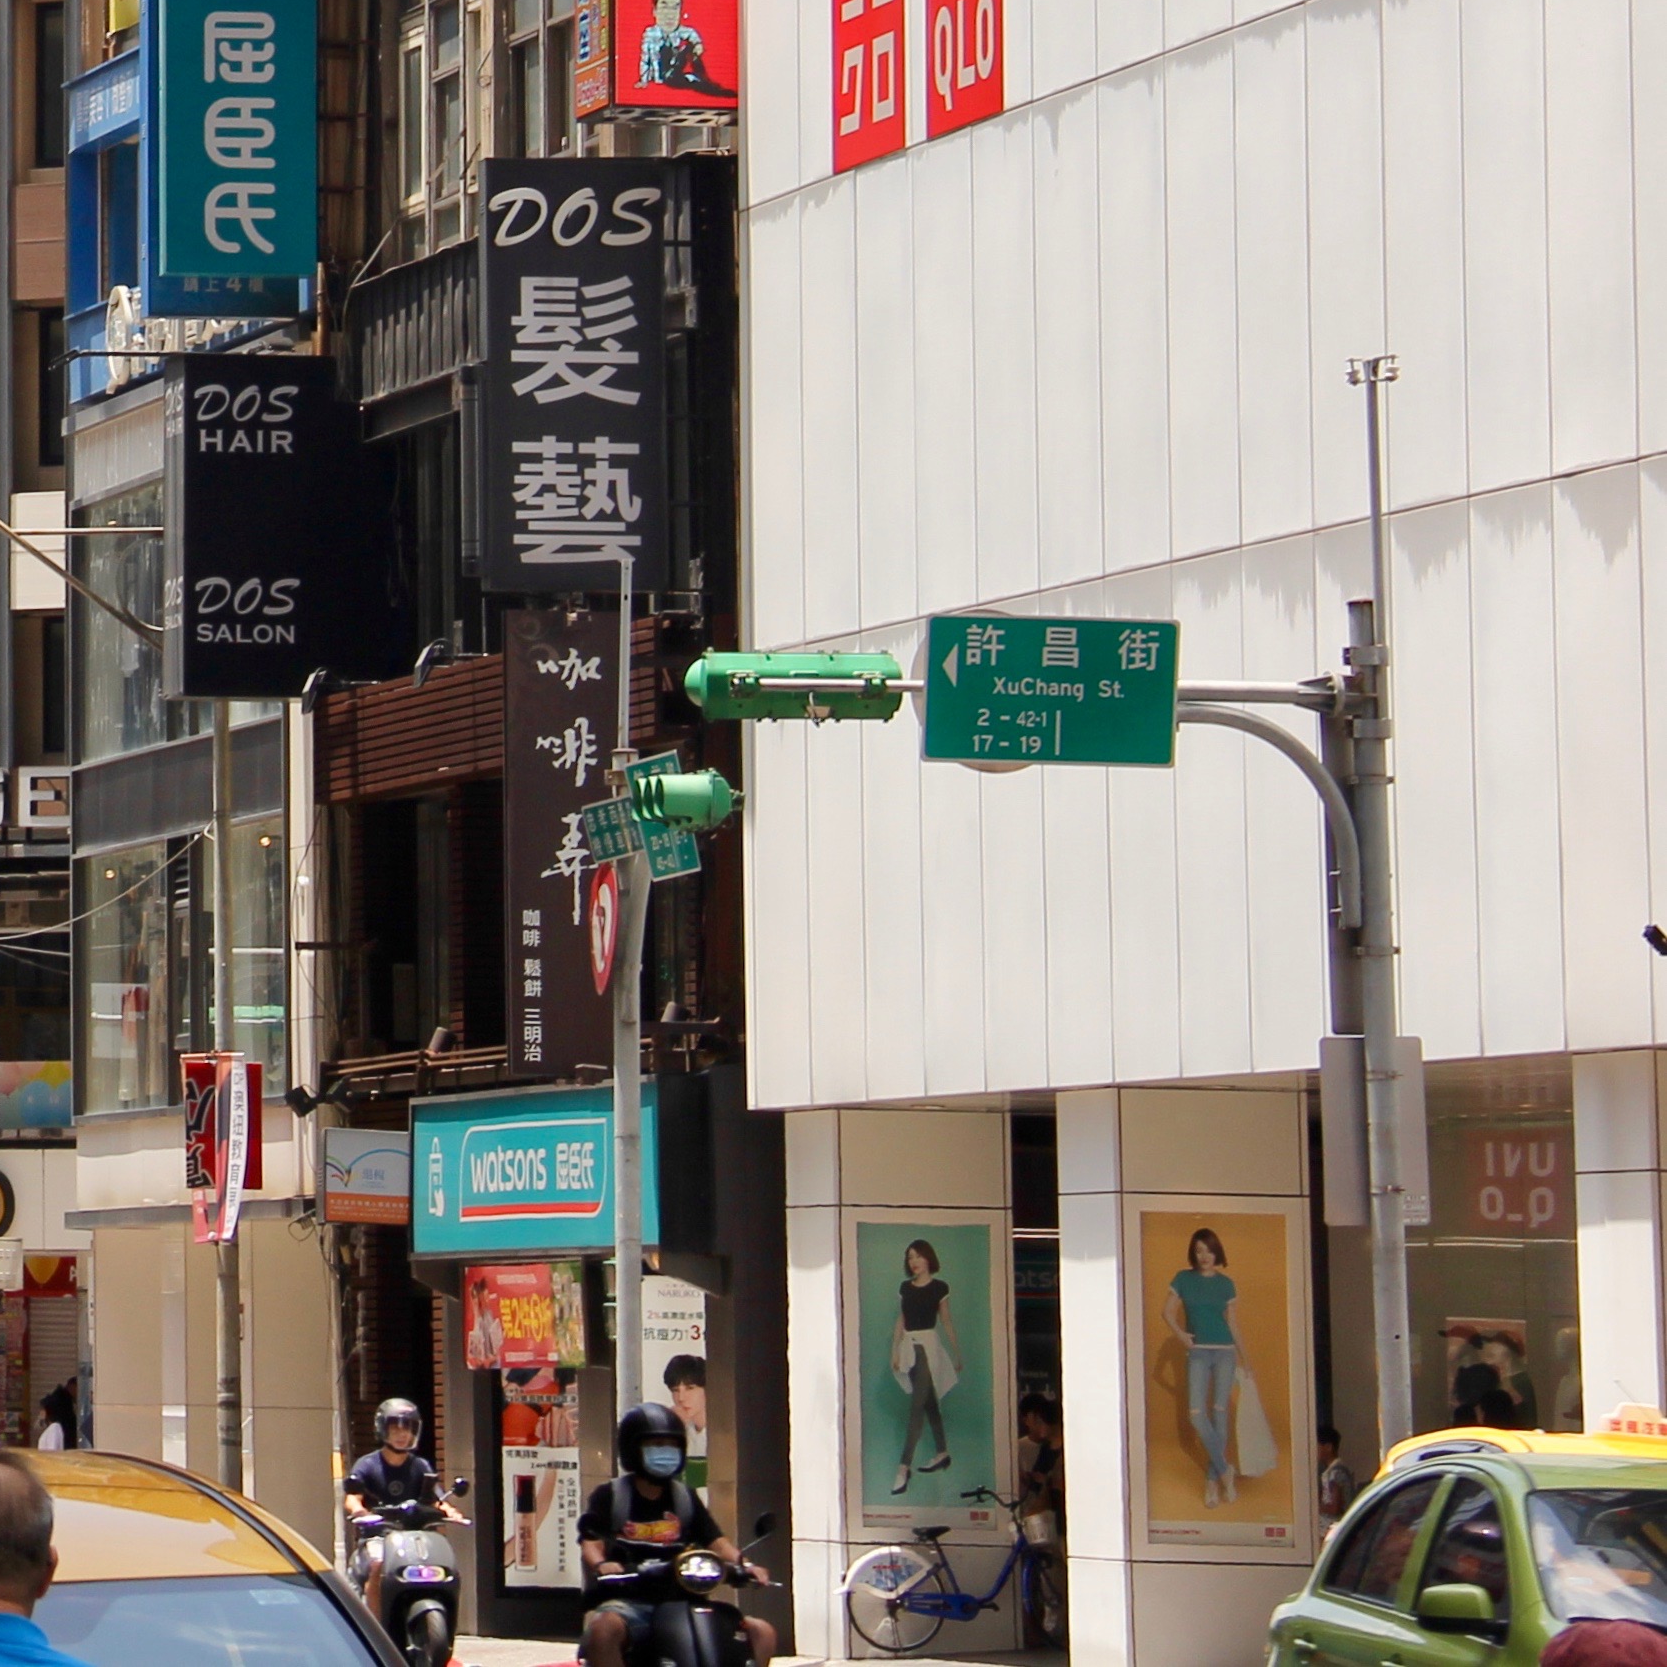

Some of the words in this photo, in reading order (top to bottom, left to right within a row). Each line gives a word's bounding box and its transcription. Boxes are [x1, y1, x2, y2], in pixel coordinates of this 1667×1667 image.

[204, 11, 276, 255] 屈臣氏
[488, 186, 662, 247] DOS
[194, 384, 300, 423] DOS
[510, 275, 643, 565] 髮藝
[198, 429, 294, 455] HAIR
[194, 576, 302, 616] DOS
[196, 623, 297, 644] SALON
[965, 624, 1160, 671] 許昌街
[992, 677, 1084, 702] XuChang
[1098, 679, 1125, 699] St.
[522, 908, 542, 948] 咖啡
[523, 959, 543, 999] 鬆餅
[523, 1008, 542, 1063] 三明治
[470, 1145, 547, 1193] watsons
